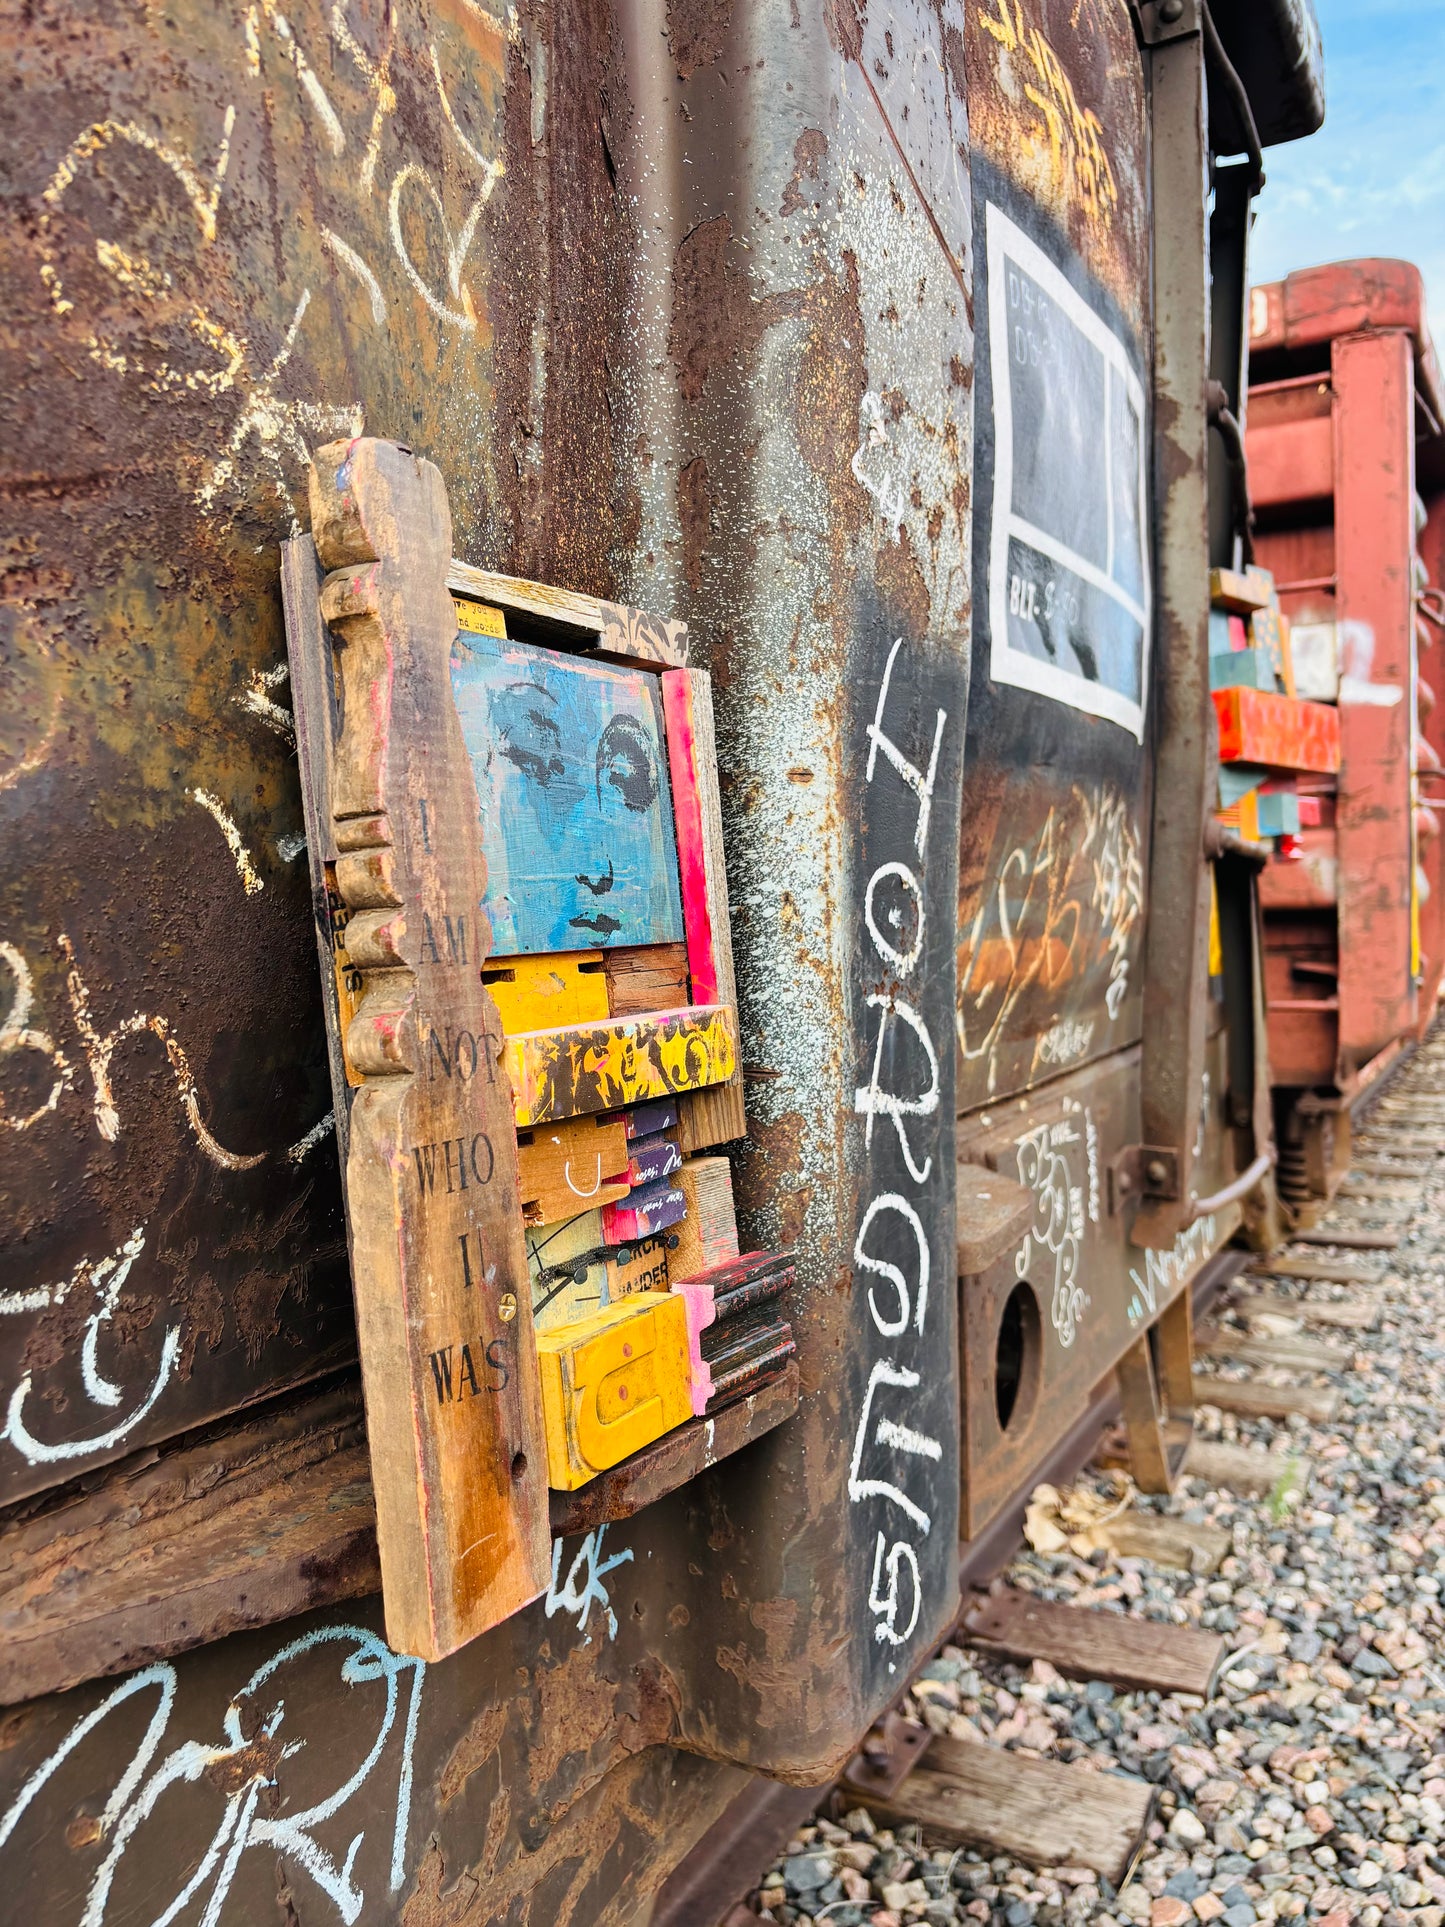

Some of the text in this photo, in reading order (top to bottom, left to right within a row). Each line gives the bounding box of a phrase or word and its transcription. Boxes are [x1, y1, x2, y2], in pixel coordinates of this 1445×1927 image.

[418, 911, 471, 965] AM
[427, 1024, 500, 1083] NOT
[411, 1131, 495, 1197] WHO
[458, 1233, 474, 1290] I
[428, 1337, 511, 1406] WAS
